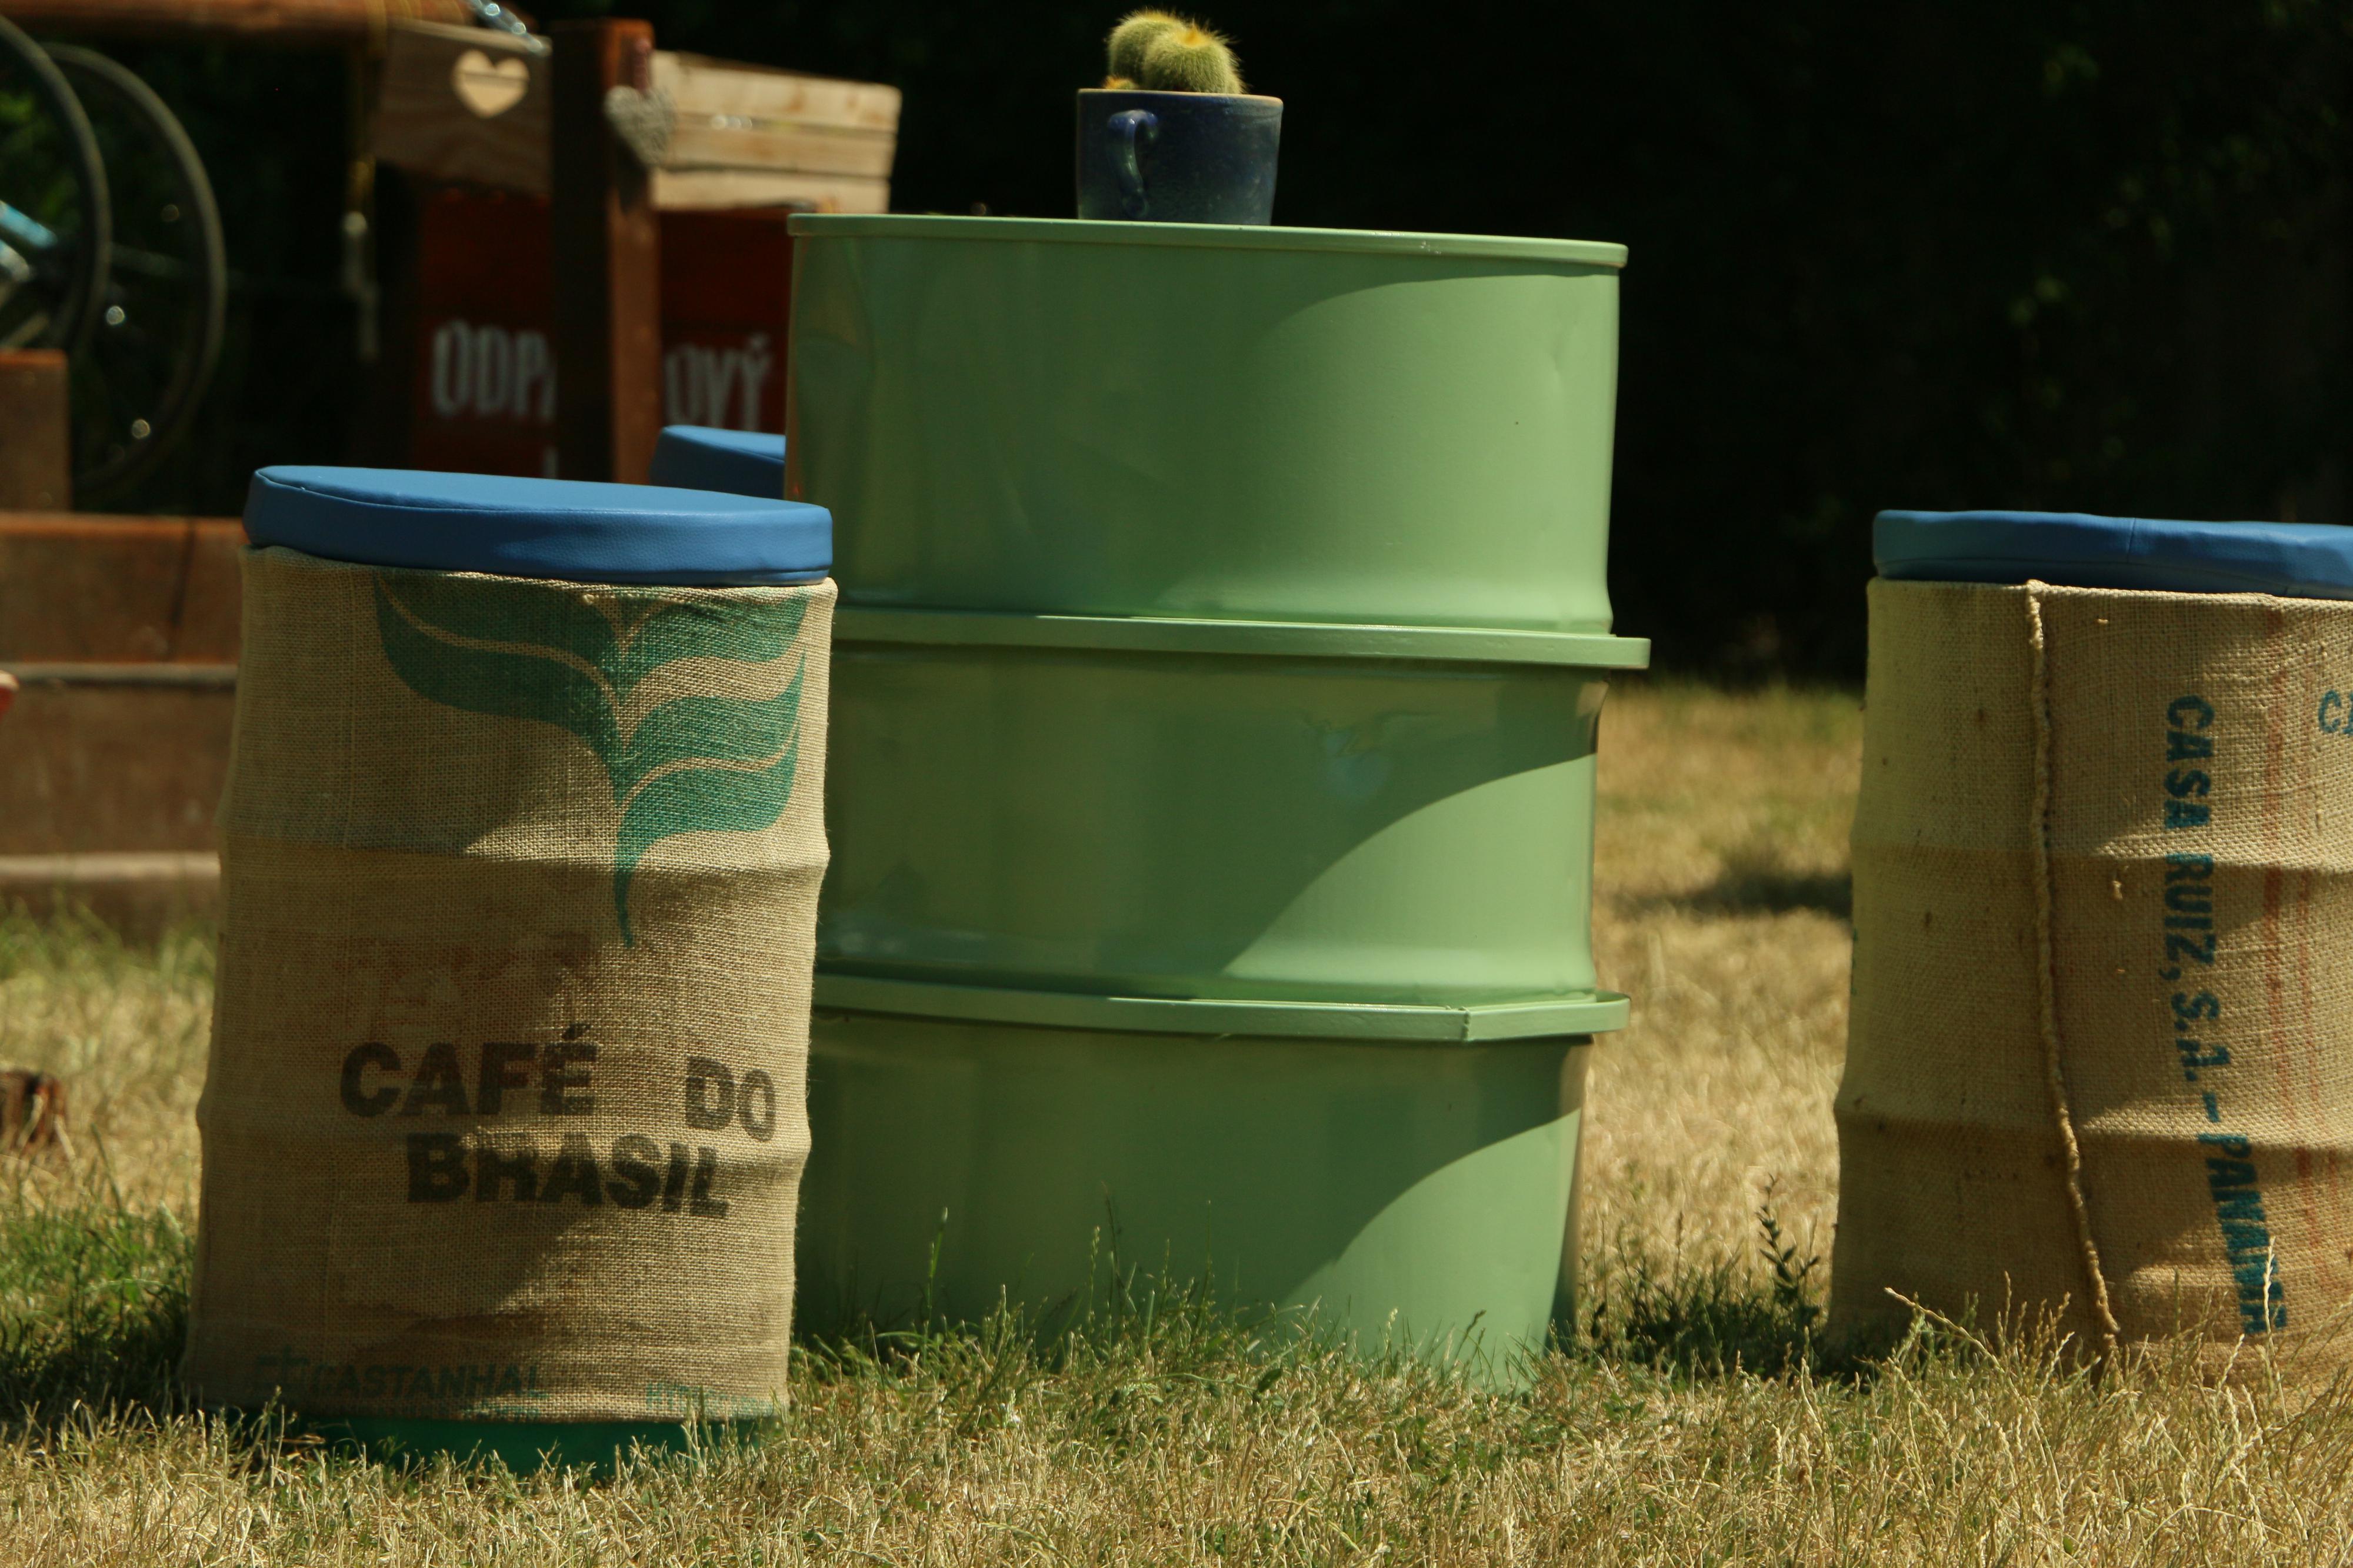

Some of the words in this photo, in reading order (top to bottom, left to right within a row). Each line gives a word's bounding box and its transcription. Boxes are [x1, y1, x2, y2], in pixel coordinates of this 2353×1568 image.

[2164, 694, 2217, 829] CASA
[2158, 852, 2217, 980] RUIZ,
[339, 1023, 599, 1118] CAFÉ
[685, 1055, 777, 1142] DO
[2171, 991, 2230, 1082] S.A.
[406, 1131, 731, 1219] BRASIL
[312, 1362, 549, 1397] CASTANHAL
